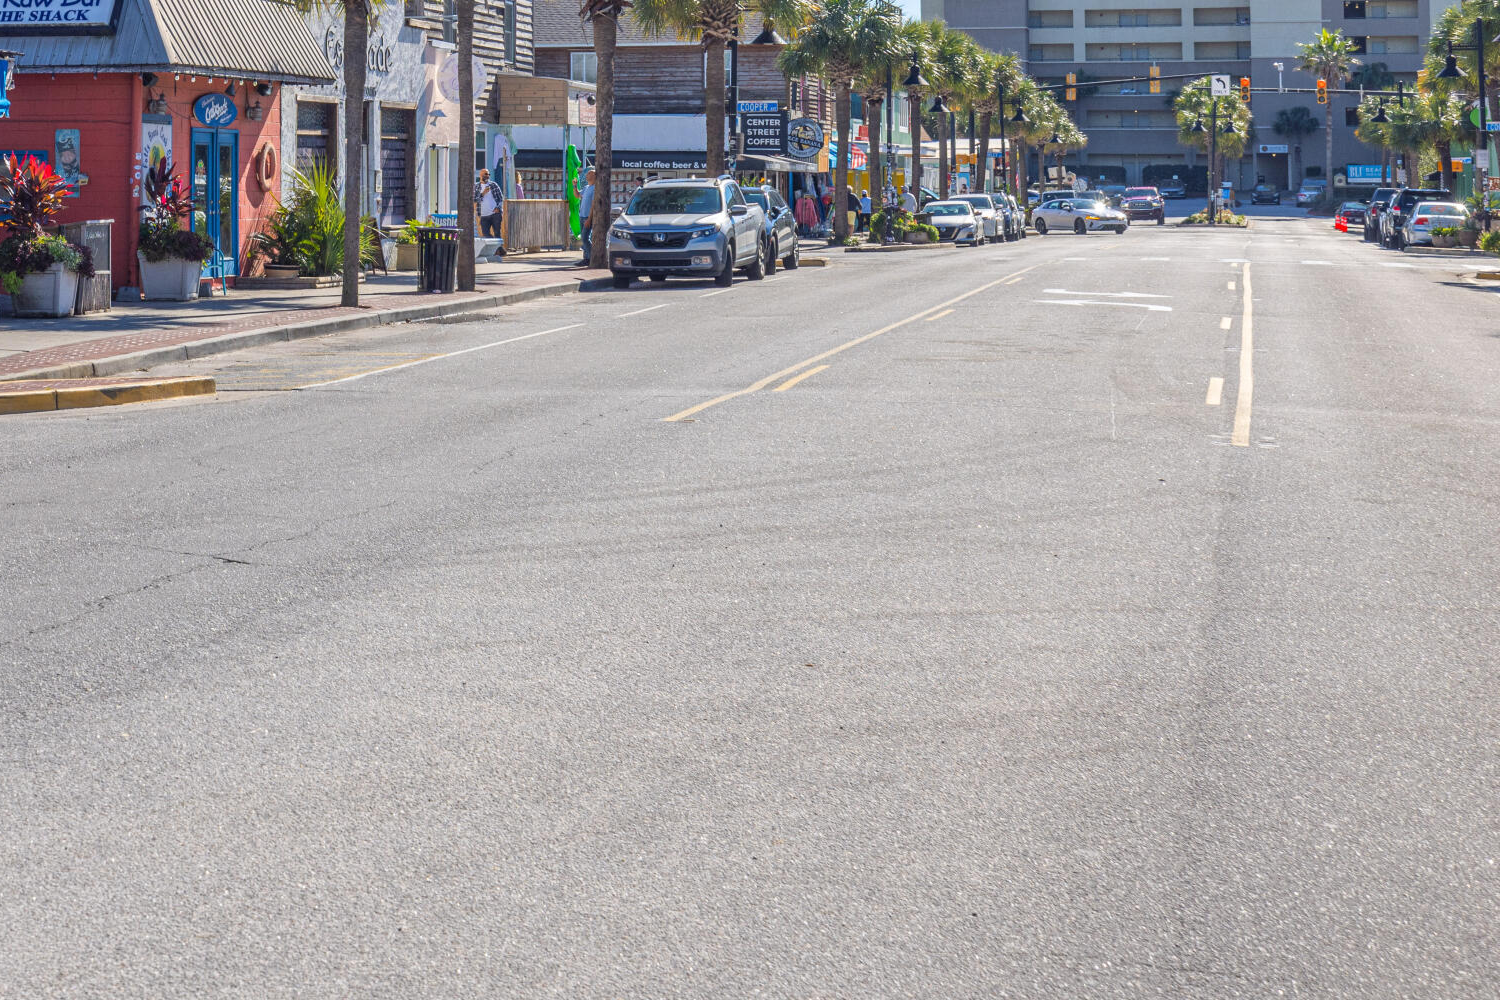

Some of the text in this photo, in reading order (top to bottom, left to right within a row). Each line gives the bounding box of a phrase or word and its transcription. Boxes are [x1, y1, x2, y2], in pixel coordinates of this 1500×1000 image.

[29, 9, 91, 22] SHACK
[740, 103, 768, 112] COOPER
[747, 138, 780, 146] COFFEE
[622, 160, 641, 168] local
[643, 160, 670, 168] coffee
